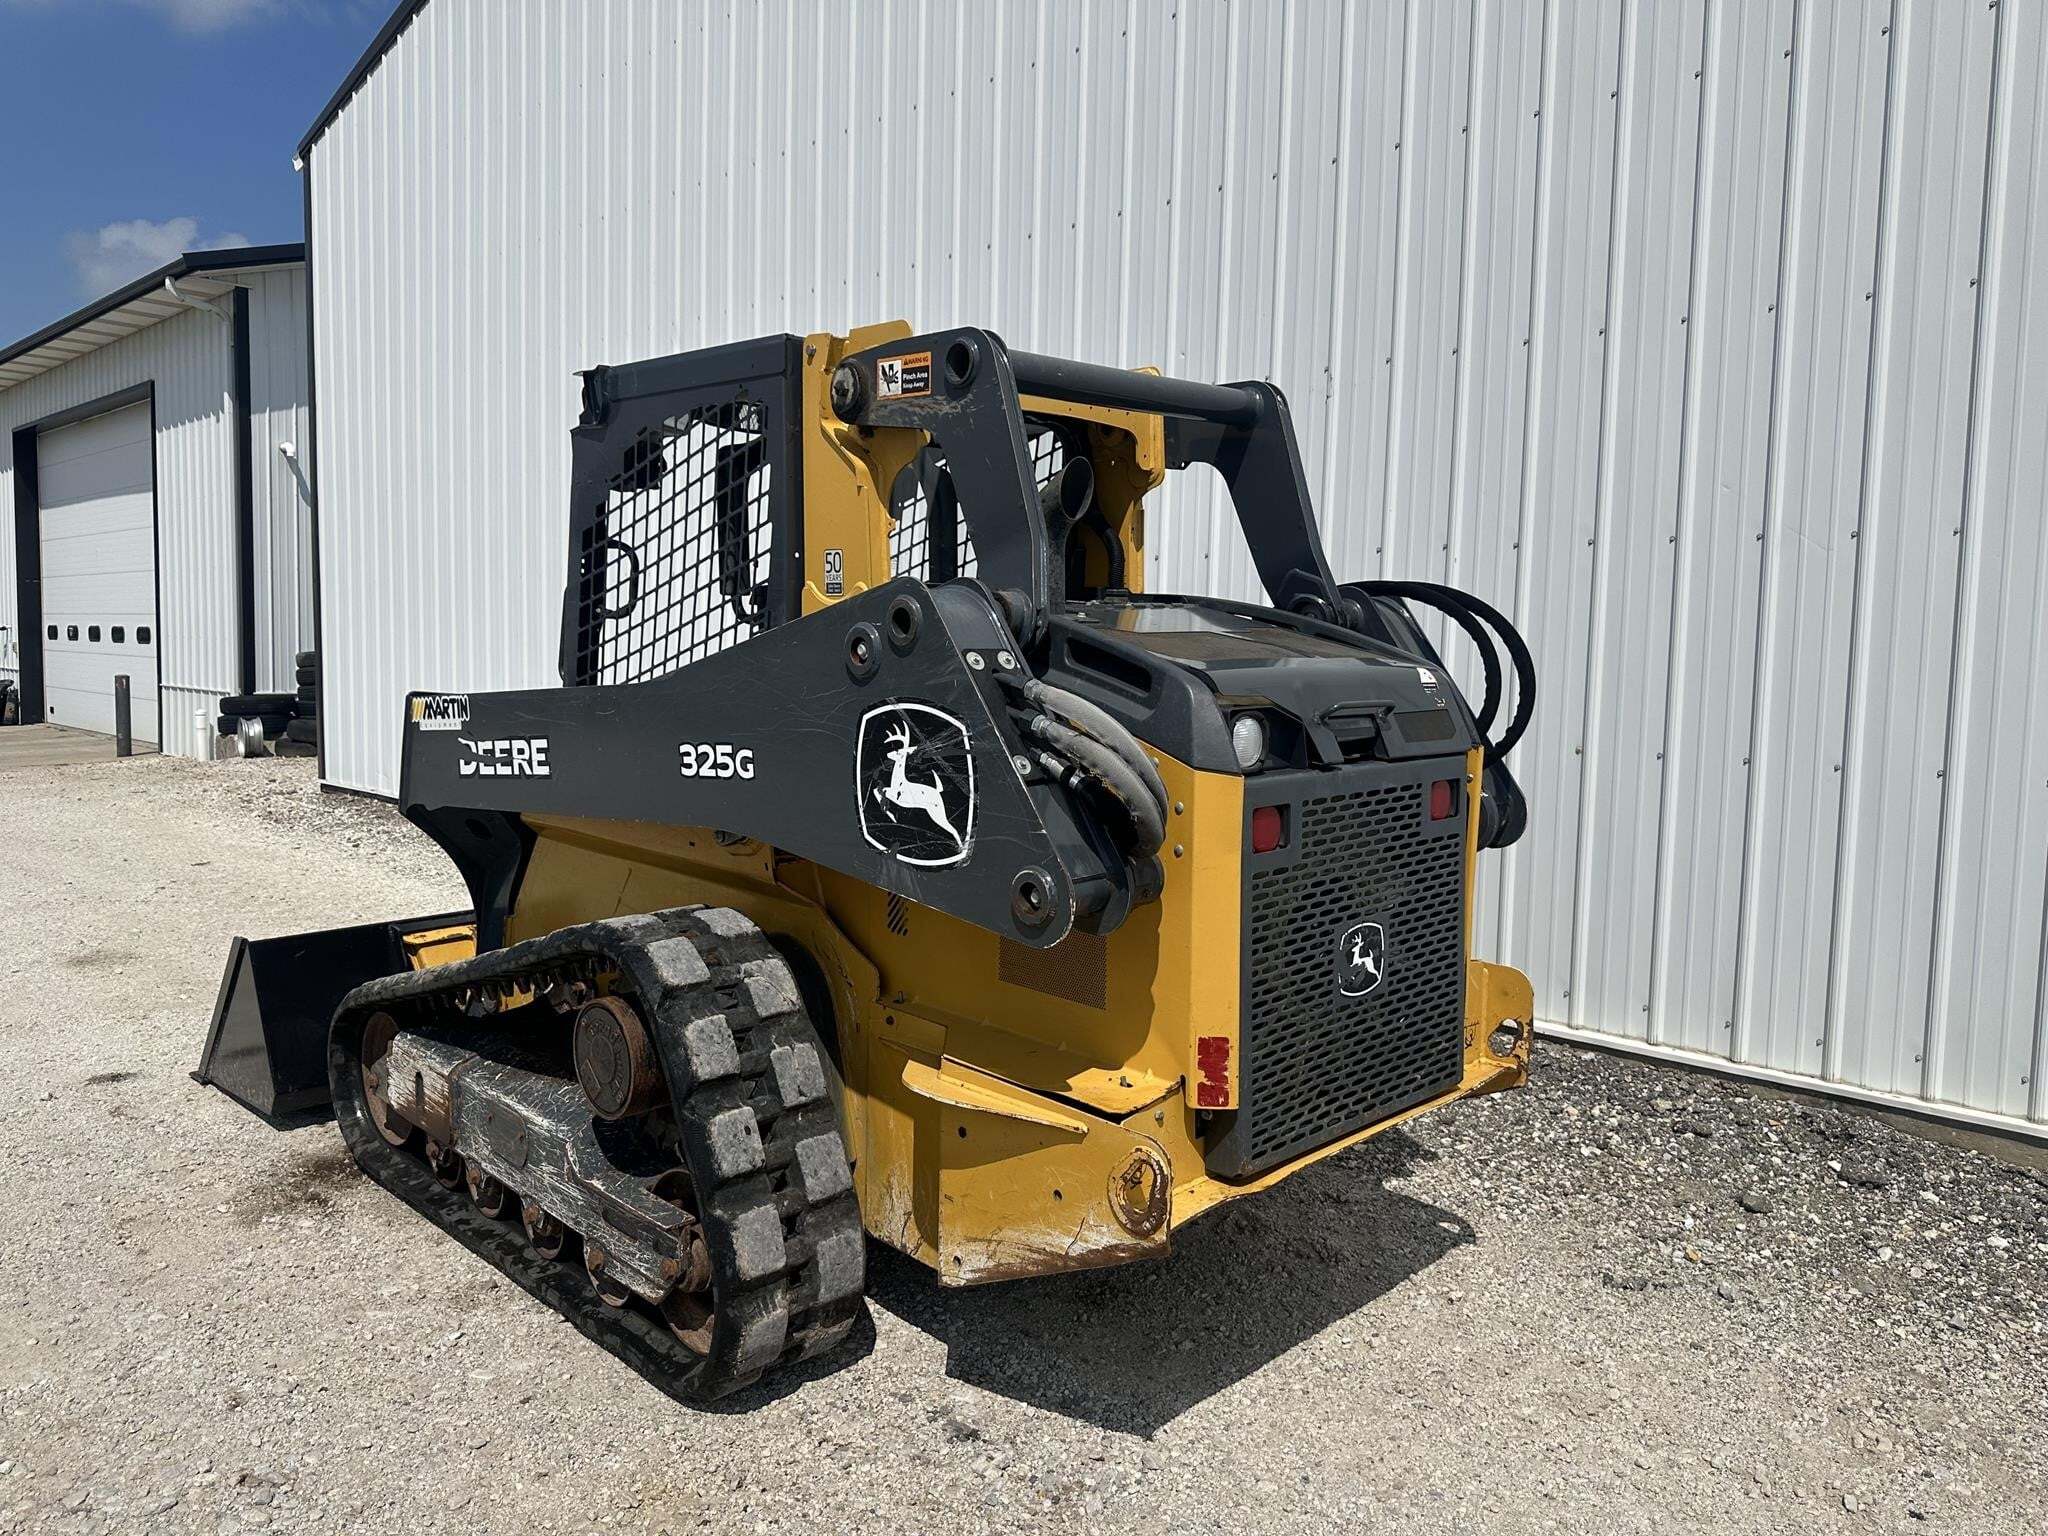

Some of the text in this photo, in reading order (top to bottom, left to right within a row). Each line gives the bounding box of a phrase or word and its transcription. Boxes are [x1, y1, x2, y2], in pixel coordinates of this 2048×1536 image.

[825, 552, 842, 573] 50
[423, 697, 469, 720] MARTIN
[679, 743, 755, 779] 325G
